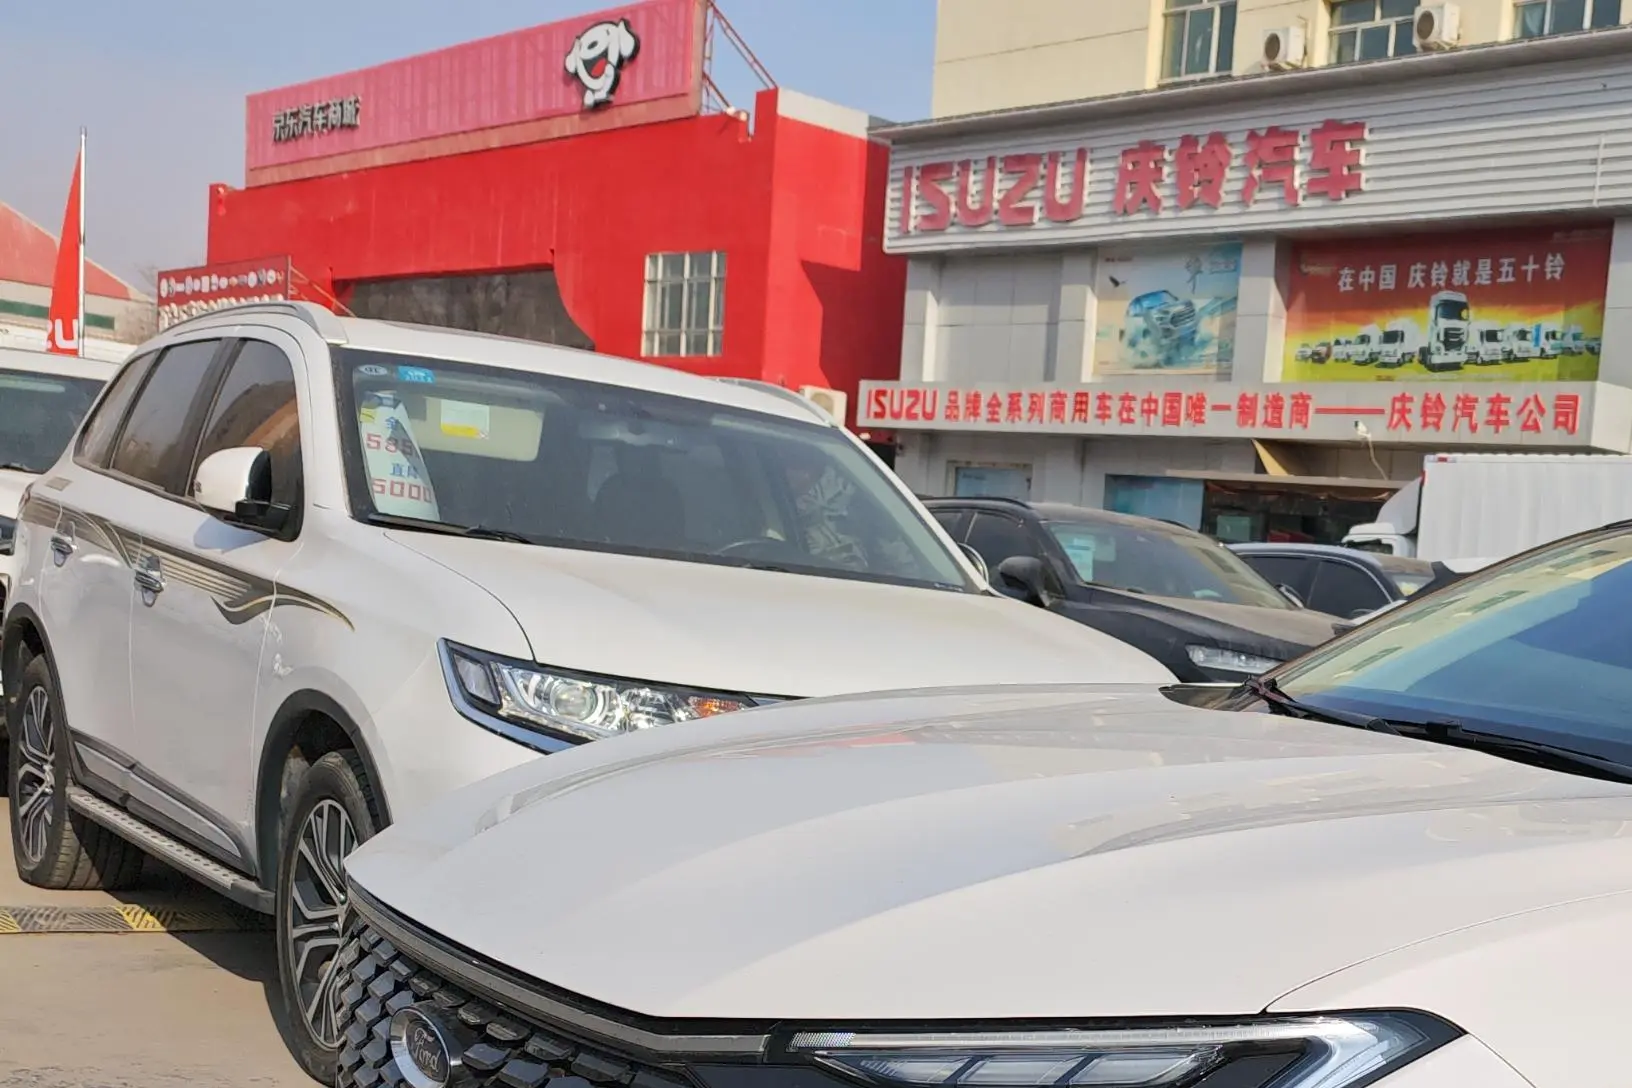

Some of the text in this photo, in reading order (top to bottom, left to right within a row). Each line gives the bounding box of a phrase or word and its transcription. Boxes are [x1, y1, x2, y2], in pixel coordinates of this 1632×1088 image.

[900, 117, 1369, 233] ISUZU 庆铃汽车
[1337, 264, 1398, 292] 在中国
[1407, 253, 1566, 289] 庆铃就是五十铃
[866, 389, 938, 420] ISUZU
[413, 1027, 442, 1073] Ford
